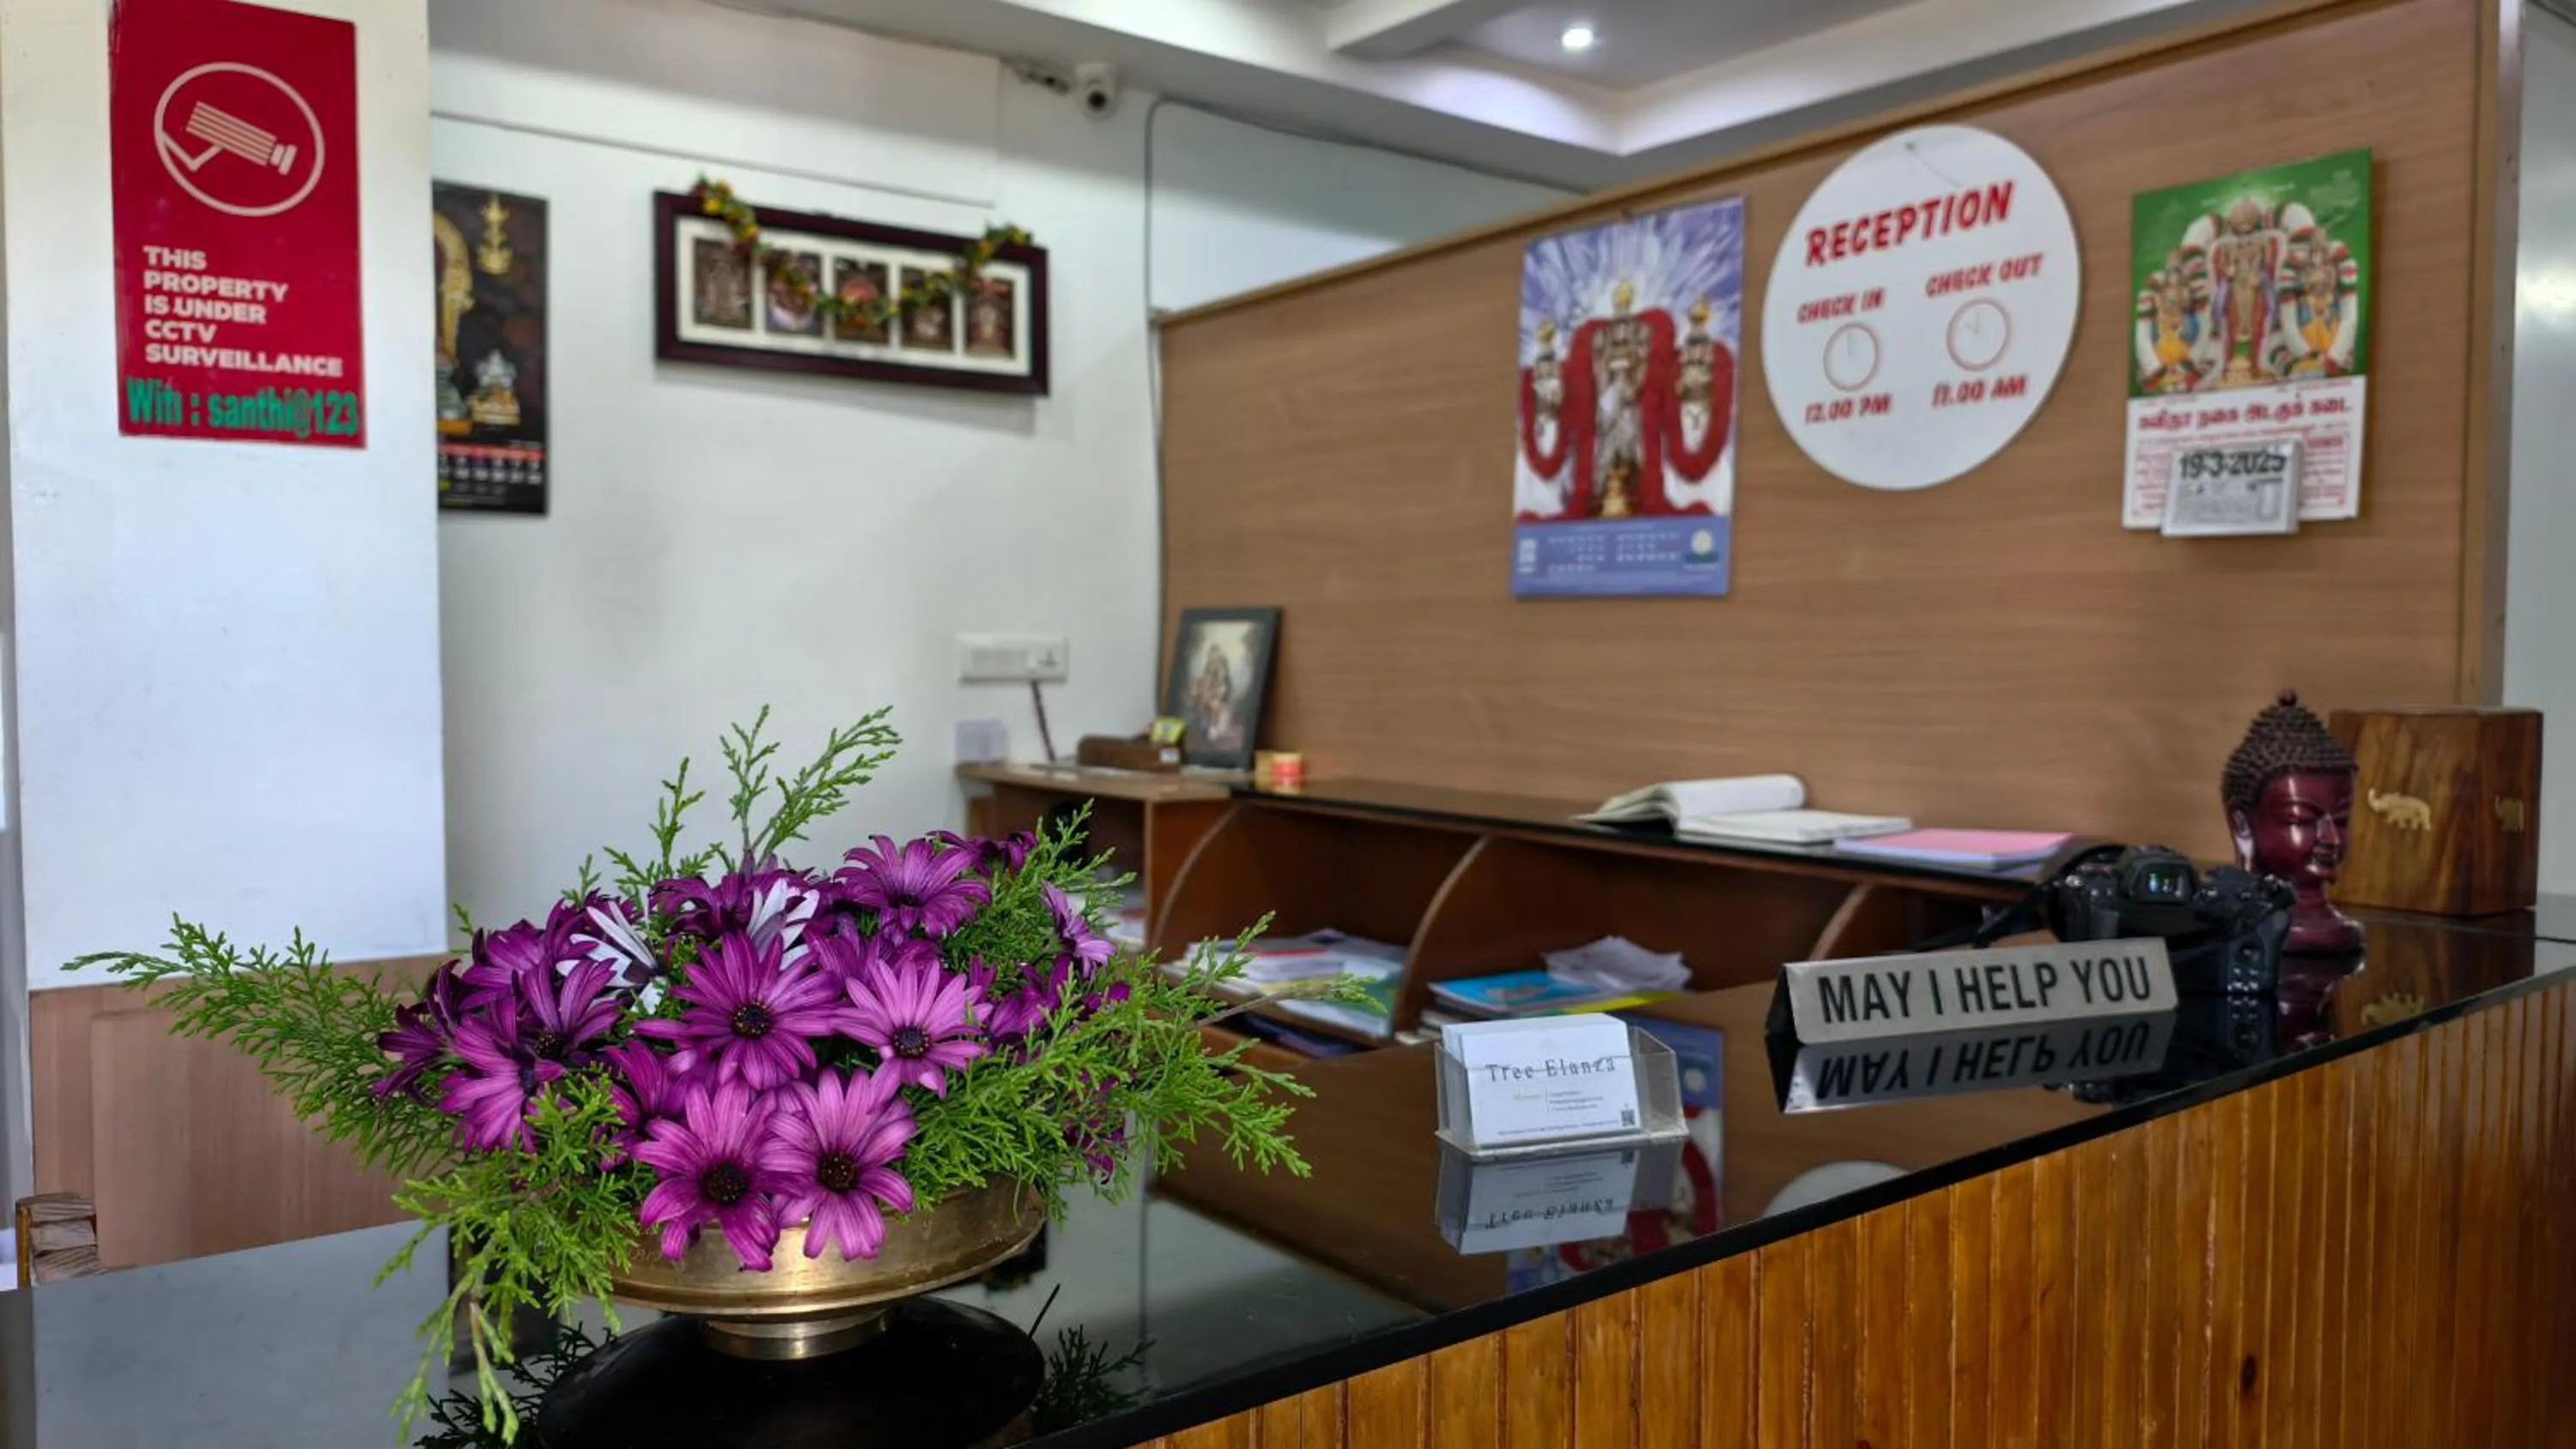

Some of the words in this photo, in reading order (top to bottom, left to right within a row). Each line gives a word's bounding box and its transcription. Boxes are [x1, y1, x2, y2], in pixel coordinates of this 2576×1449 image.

[1806, 179, 2014, 267] RECEPTION
[143, 246, 207, 270] THIS
[143, 270, 289, 302] PROPERTY
[1925, 264, 1993, 297] CHECK
[1999, 252, 2044, 282] OUT
[144, 294, 169, 315] IS
[173, 297, 266, 324] UNDER
[1796, 294, 1856, 324] CHECK
[1862, 288, 1885, 311] IN
[144, 319, 216, 343] CCTV
[145, 343, 343, 378] SURVEILLANCE
[1991, 375, 2027, 399] AM
[1859, 393, 1892, 416] PM
[1818, 971, 1911, 1024] MAY
[1929, 970, 1944, 1016] I
[1956, 961, 2058, 1014] HELP
[2071, 956, 2151, 1004] YOU
[1485, 1064, 1534, 1082] Tree
